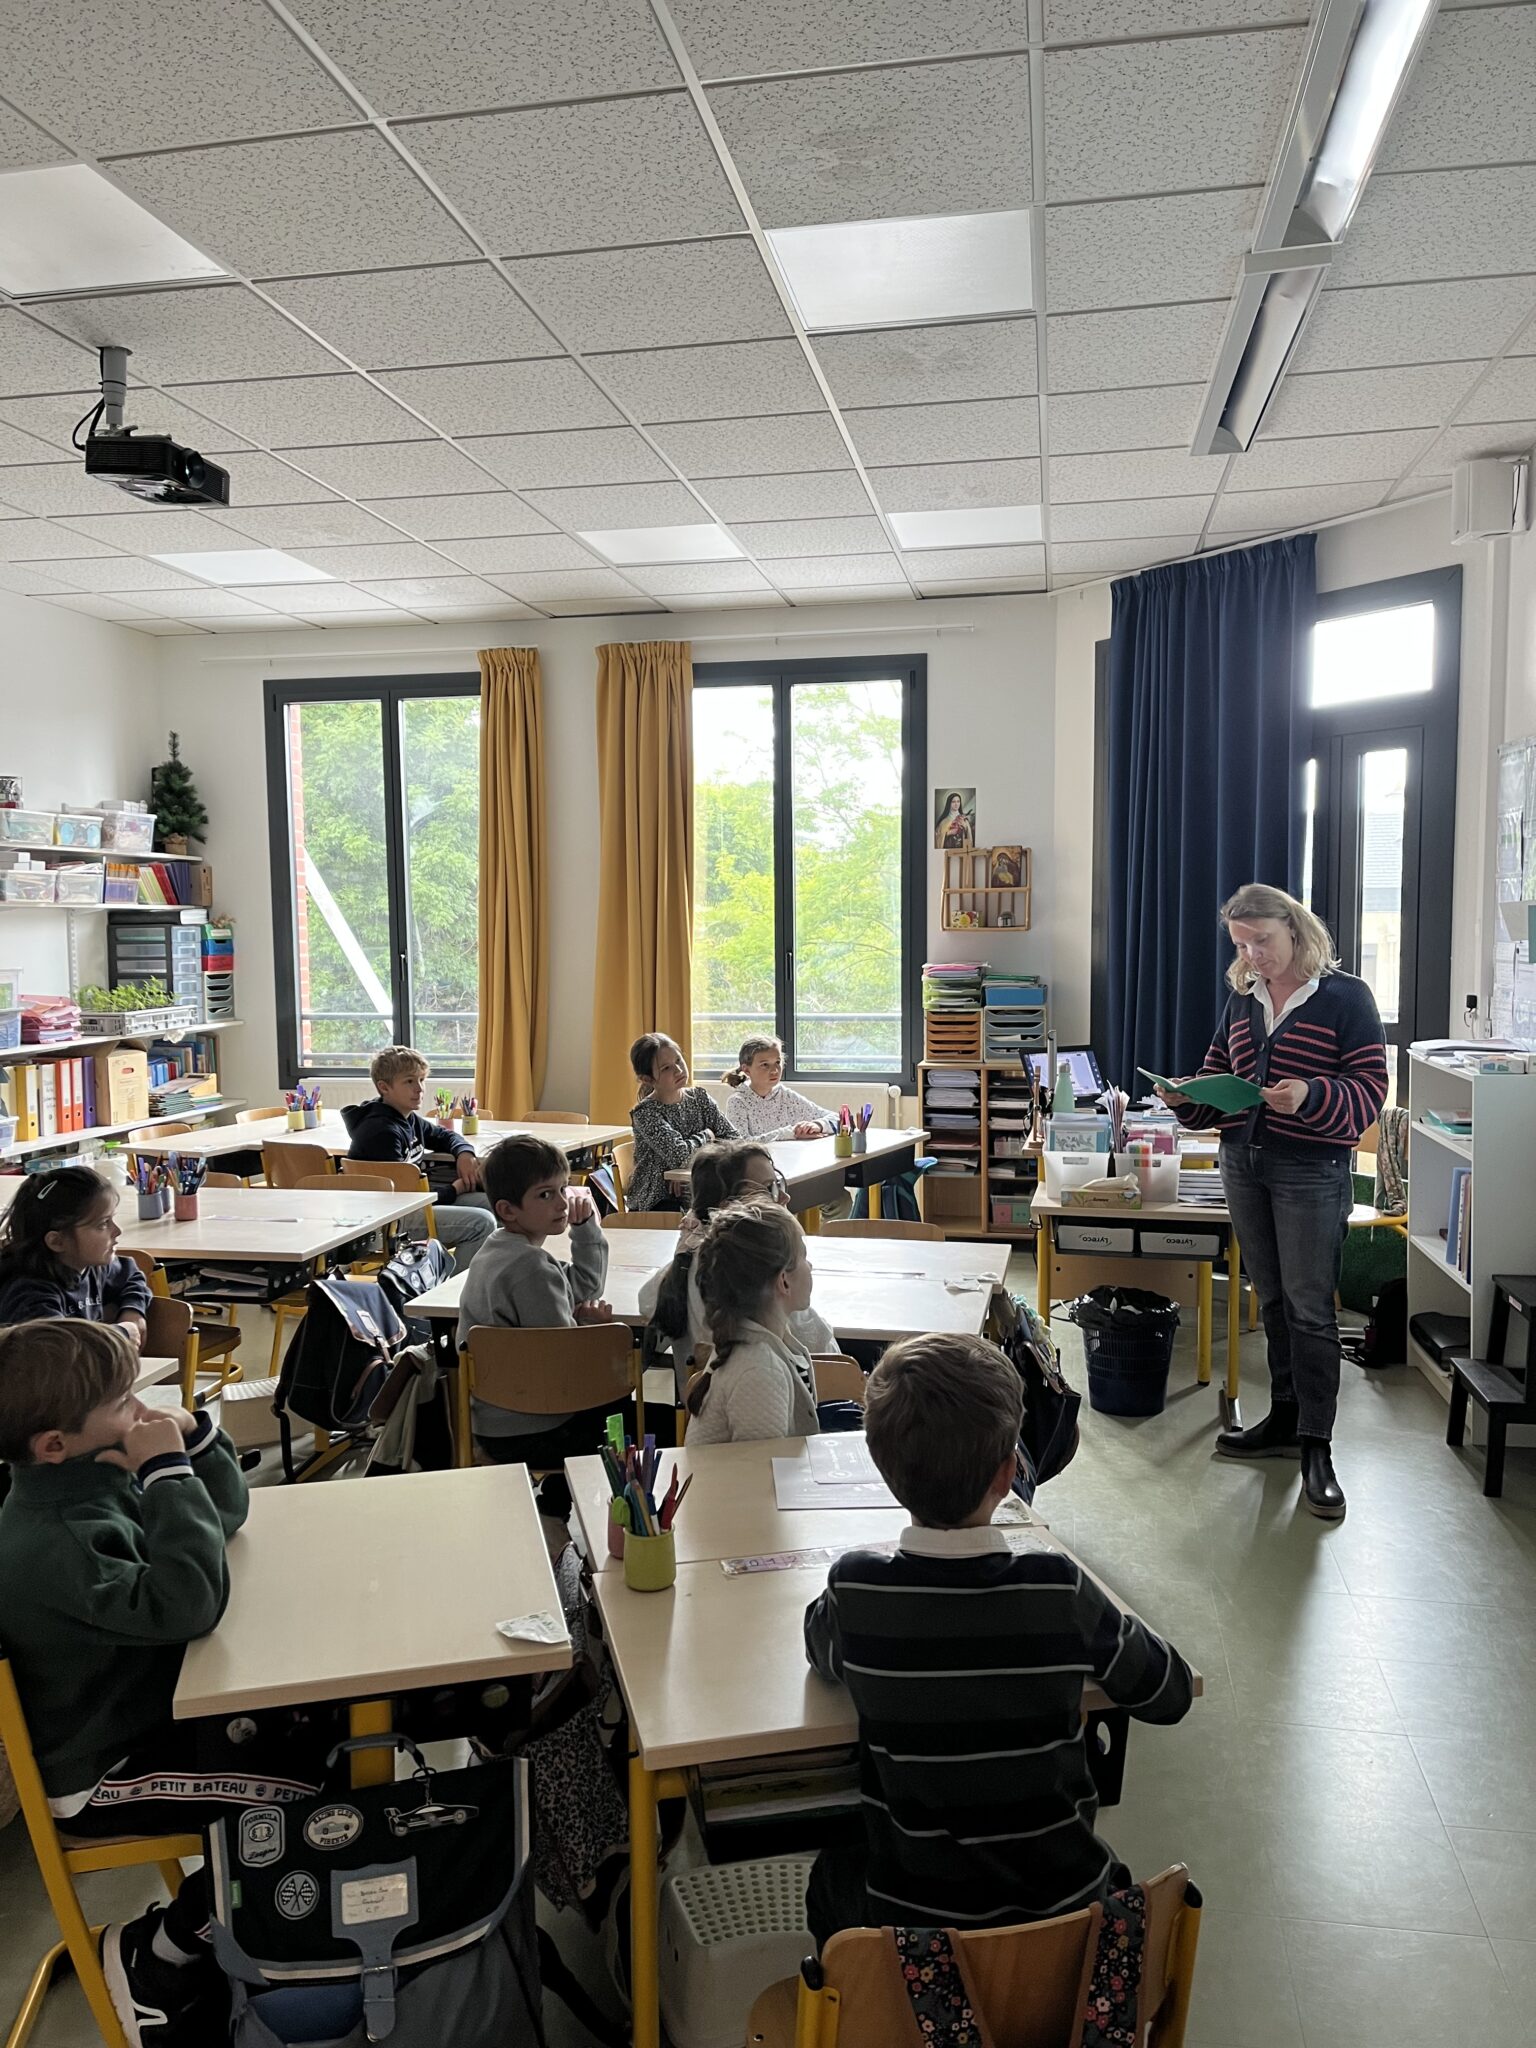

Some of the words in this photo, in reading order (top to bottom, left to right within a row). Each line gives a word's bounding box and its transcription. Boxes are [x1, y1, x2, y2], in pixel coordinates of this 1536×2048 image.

[1082, 1236, 1109, 1244] Lyreco
[1166, 1238, 1193, 1246] Lyreco
[151, 1781, 187, 1793] PETIT
[193, 1781, 247, 1794] BATEAU
[244, 1813, 279, 1827] FORMULA
